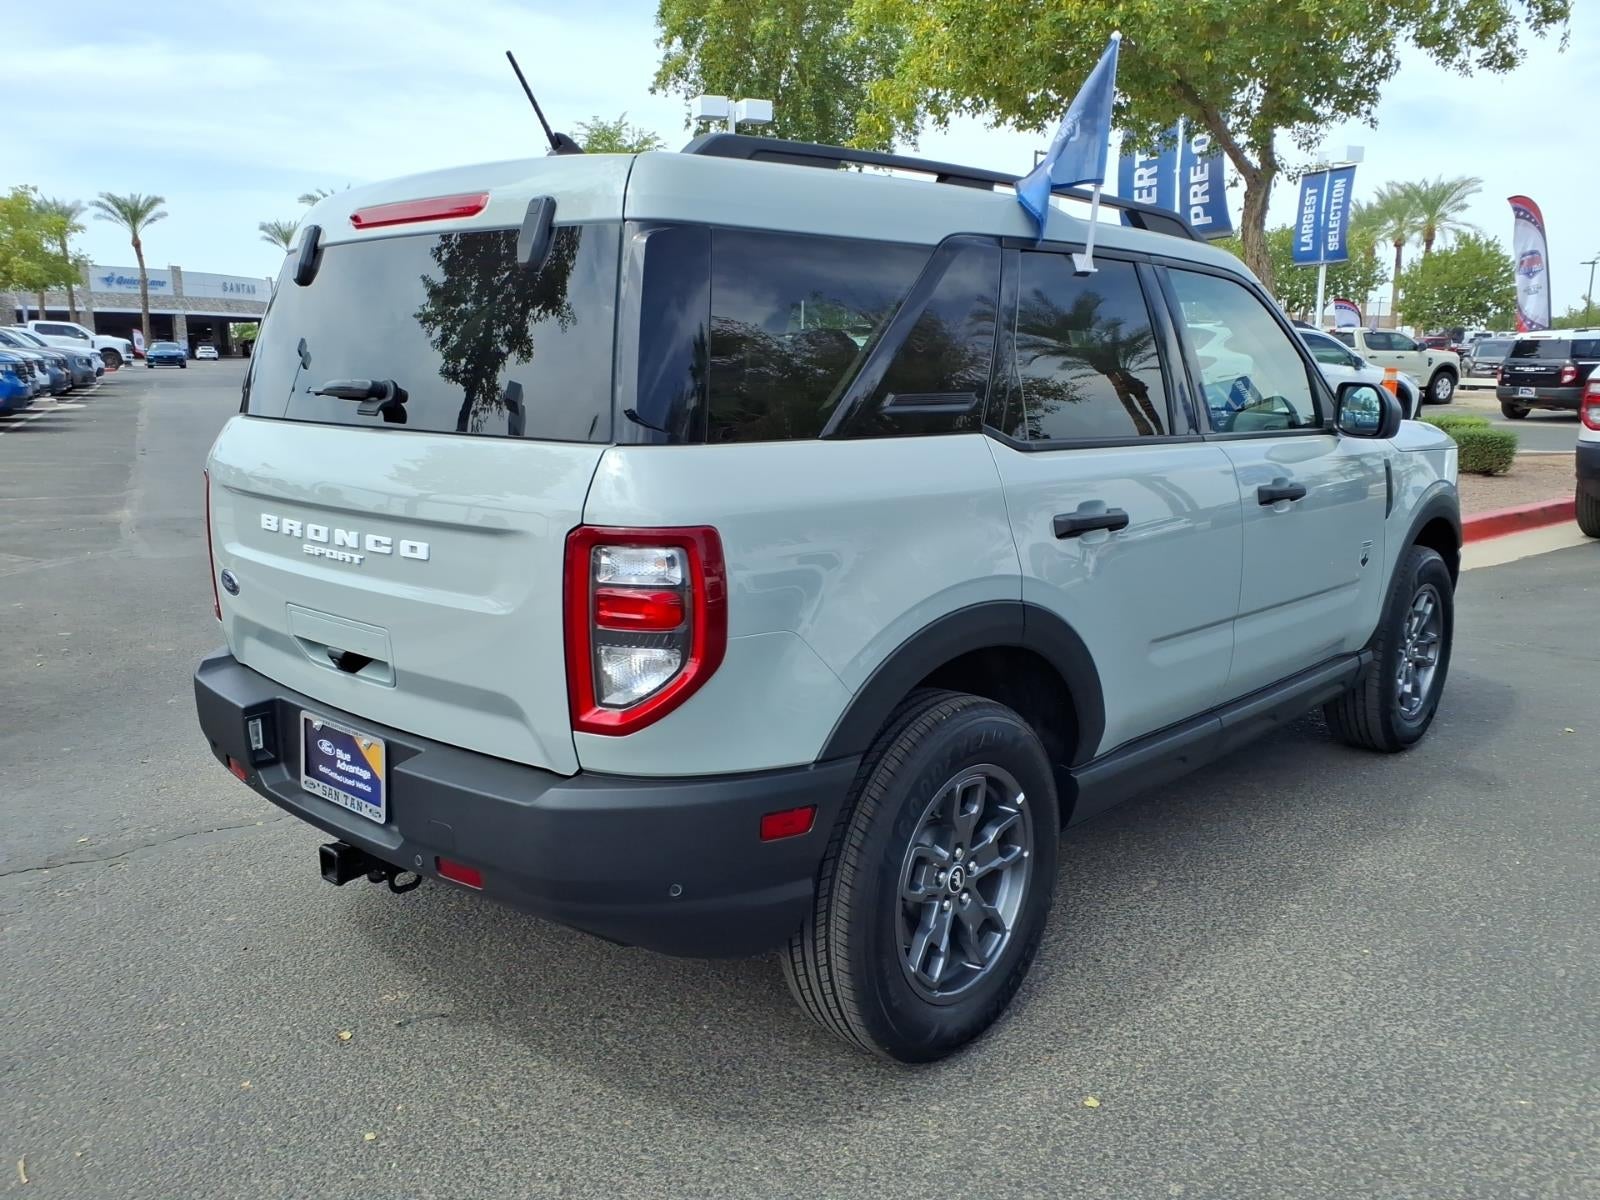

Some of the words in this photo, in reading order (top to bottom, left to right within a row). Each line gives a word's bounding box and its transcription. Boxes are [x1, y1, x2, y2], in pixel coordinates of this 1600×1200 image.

[1134, 147, 1158, 204] ERT
[1300, 186, 1318, 252] LARGEST
[1327, 177, 1347, 251] SELECTION
[261, 513, 430, 561] BRONCO
[302, 543, 365, 564] SPORT
[336, 749, 351, 761] Blue
[336, 759, 371, 780] Advantage
[321, 785, 340, 803] SAN
[343, 793, 363, 812] TAN
